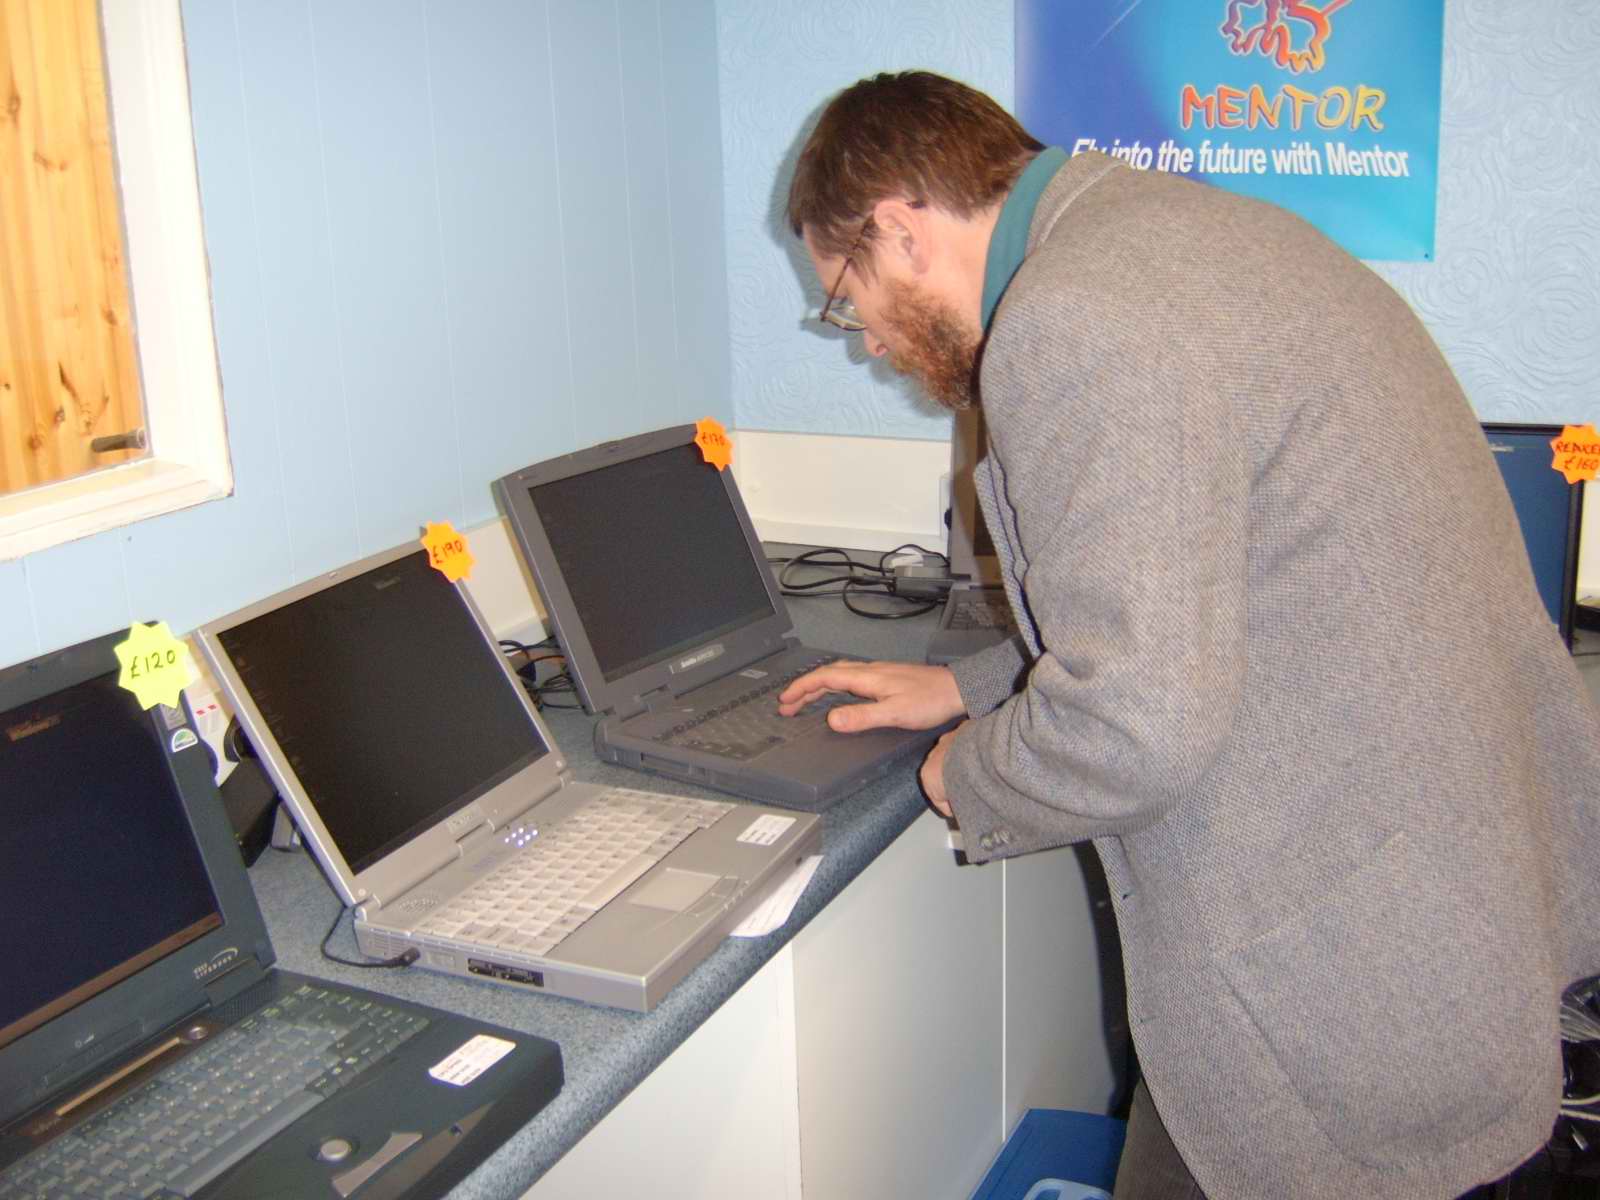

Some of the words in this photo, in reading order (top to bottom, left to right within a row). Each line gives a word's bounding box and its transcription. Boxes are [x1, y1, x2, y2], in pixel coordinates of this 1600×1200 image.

[1180, 84, 1385, 131] MENTOR
[1157, 140, 1194, 173] the
[1199, 140, 1267, 174] future
[1271, 142, 1323, 175] with
[1325, 142, 1410, 177] Mentor
[432, 540, 463, 564] £190
[130, 649, 176, 680] £120
